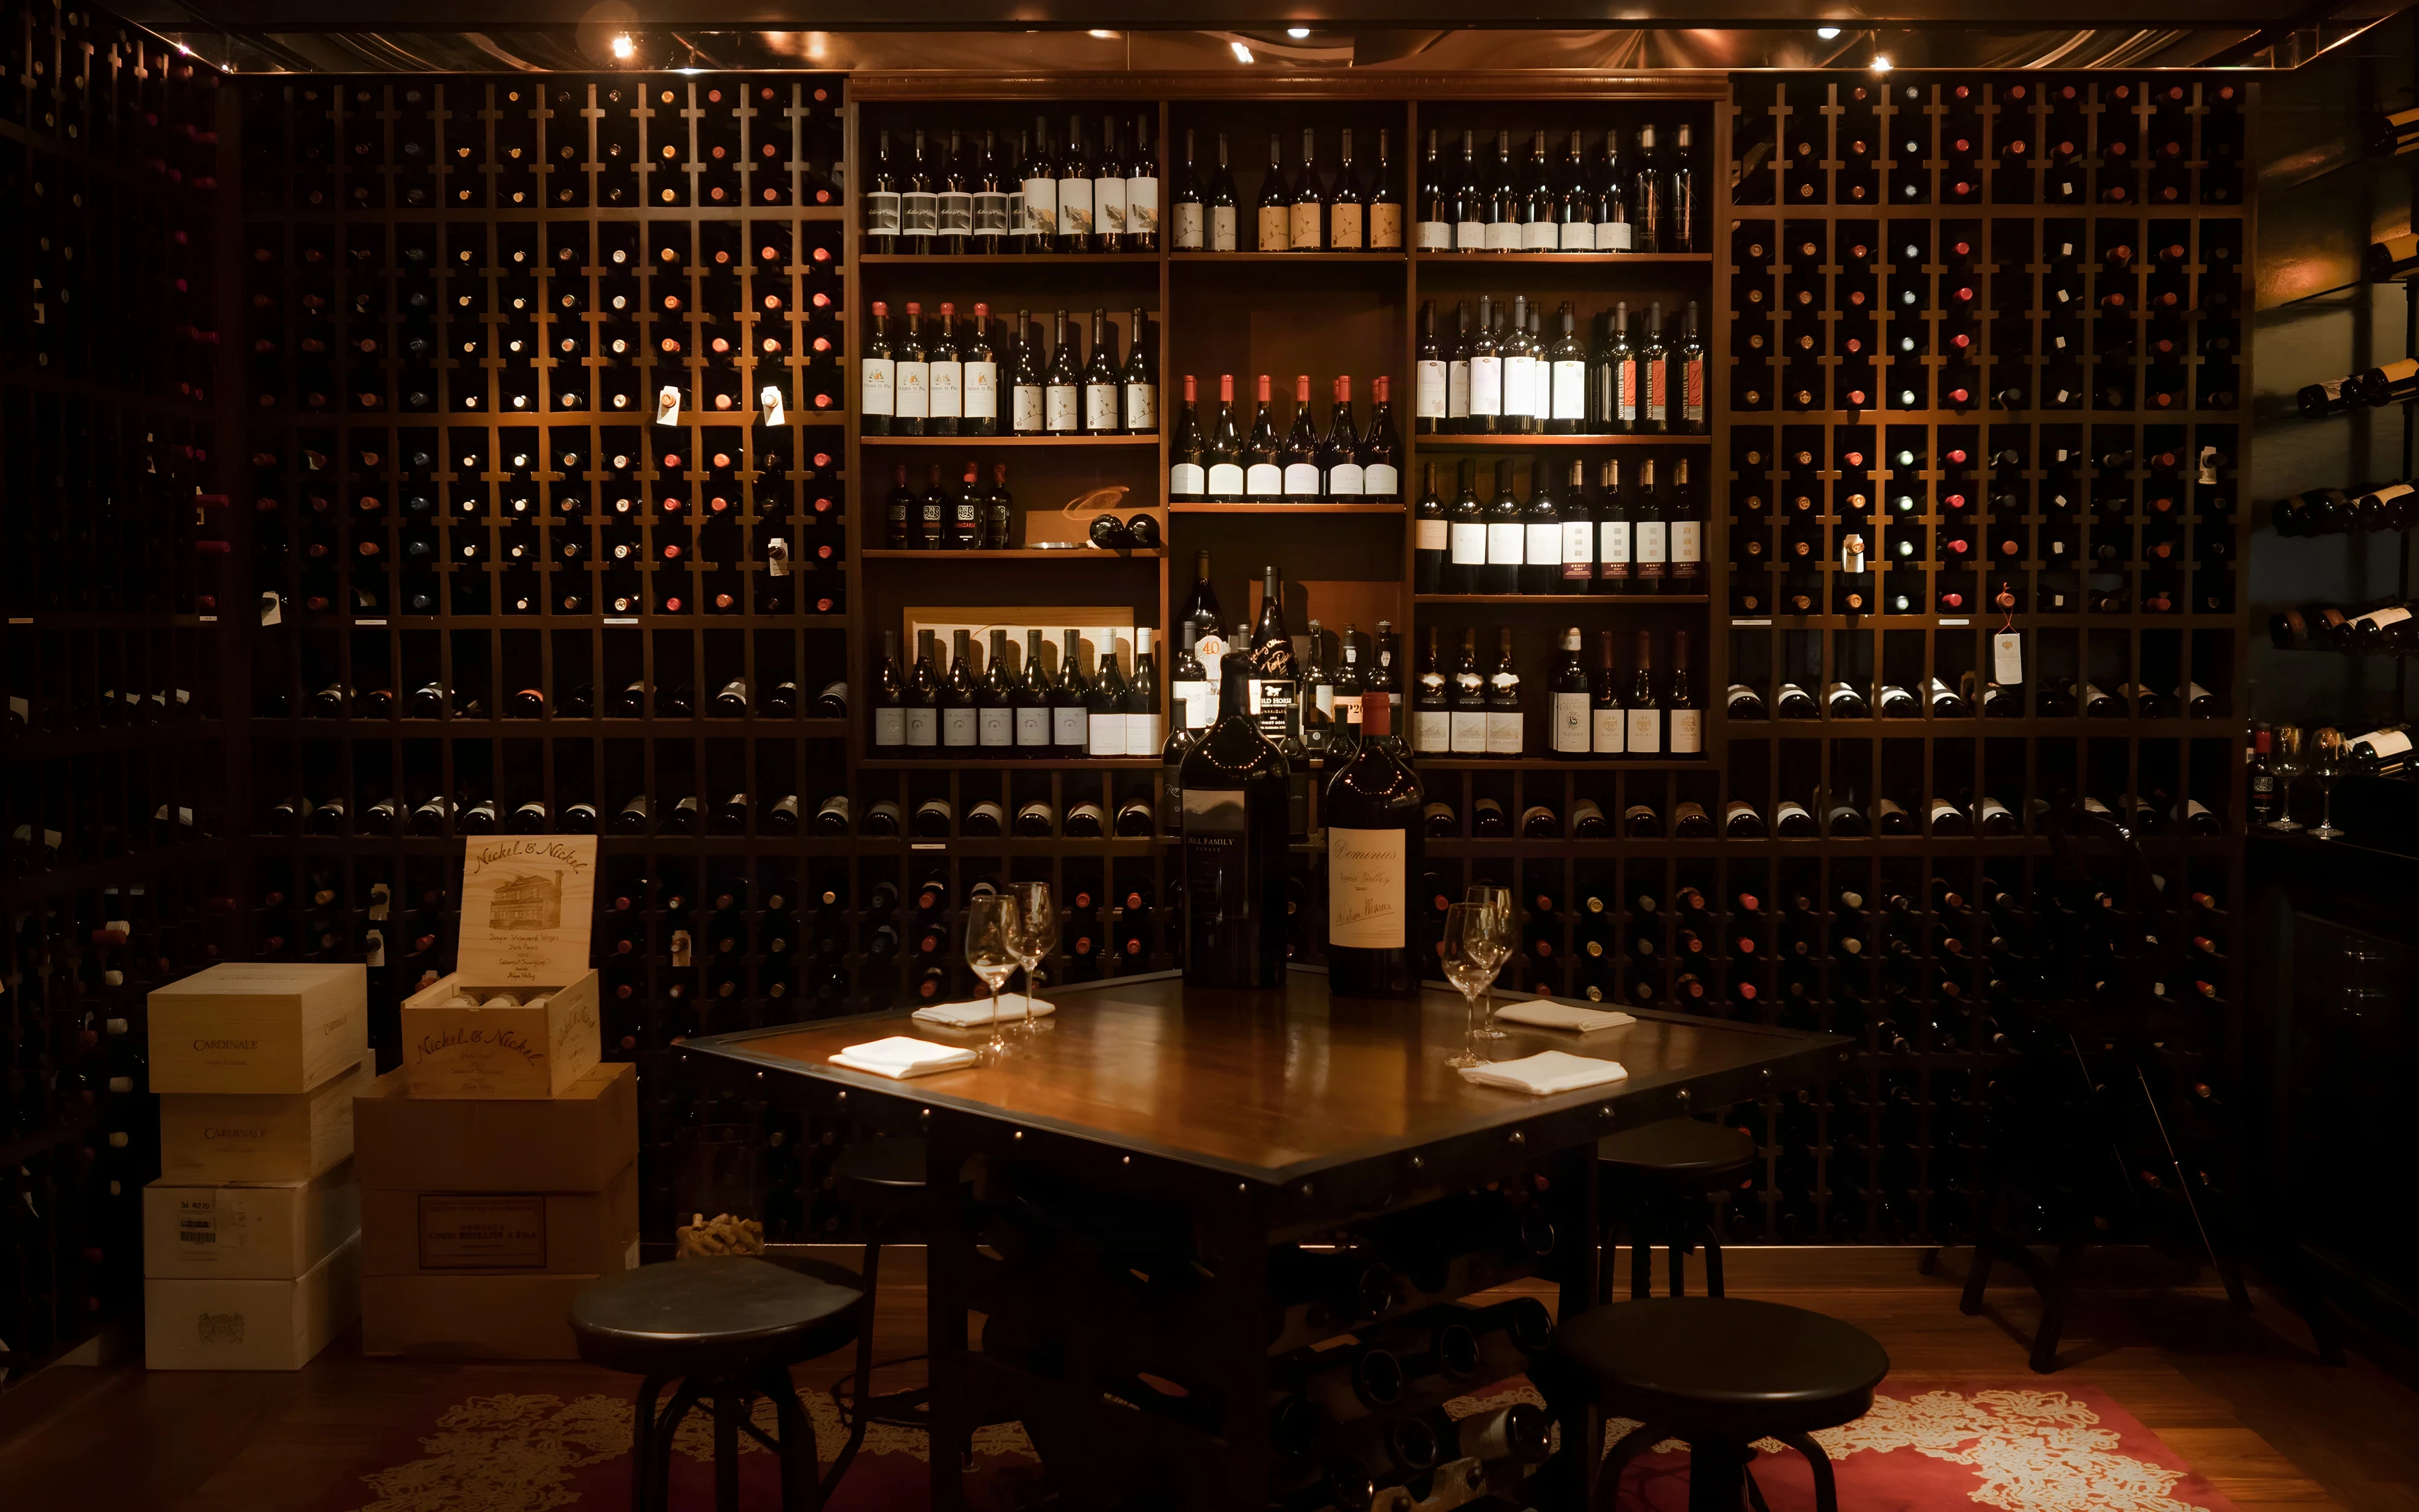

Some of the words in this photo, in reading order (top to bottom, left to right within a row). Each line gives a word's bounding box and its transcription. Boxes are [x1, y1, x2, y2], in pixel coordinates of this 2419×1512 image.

[1202, 641, 1220, 655] 40
[1203, 837, 1234, 846] FAMILY
[474, 840, 522, 874] Nickel
[525, 843, 536, 854] &
[536, 842, 588, 874] Nickel
[1333, 839, 1396, 861] Dominus
[1360, 868, 1392, 886] Valley
[193, 1039, 259, 1051] CARDINALE
[415, 1027, 471, 1065] Nickel
[470, 1030, 484, 1043] &
[483, 1029, 544, 1066] Nickel
[204, 1127, 267, 1140] CARDINALE
